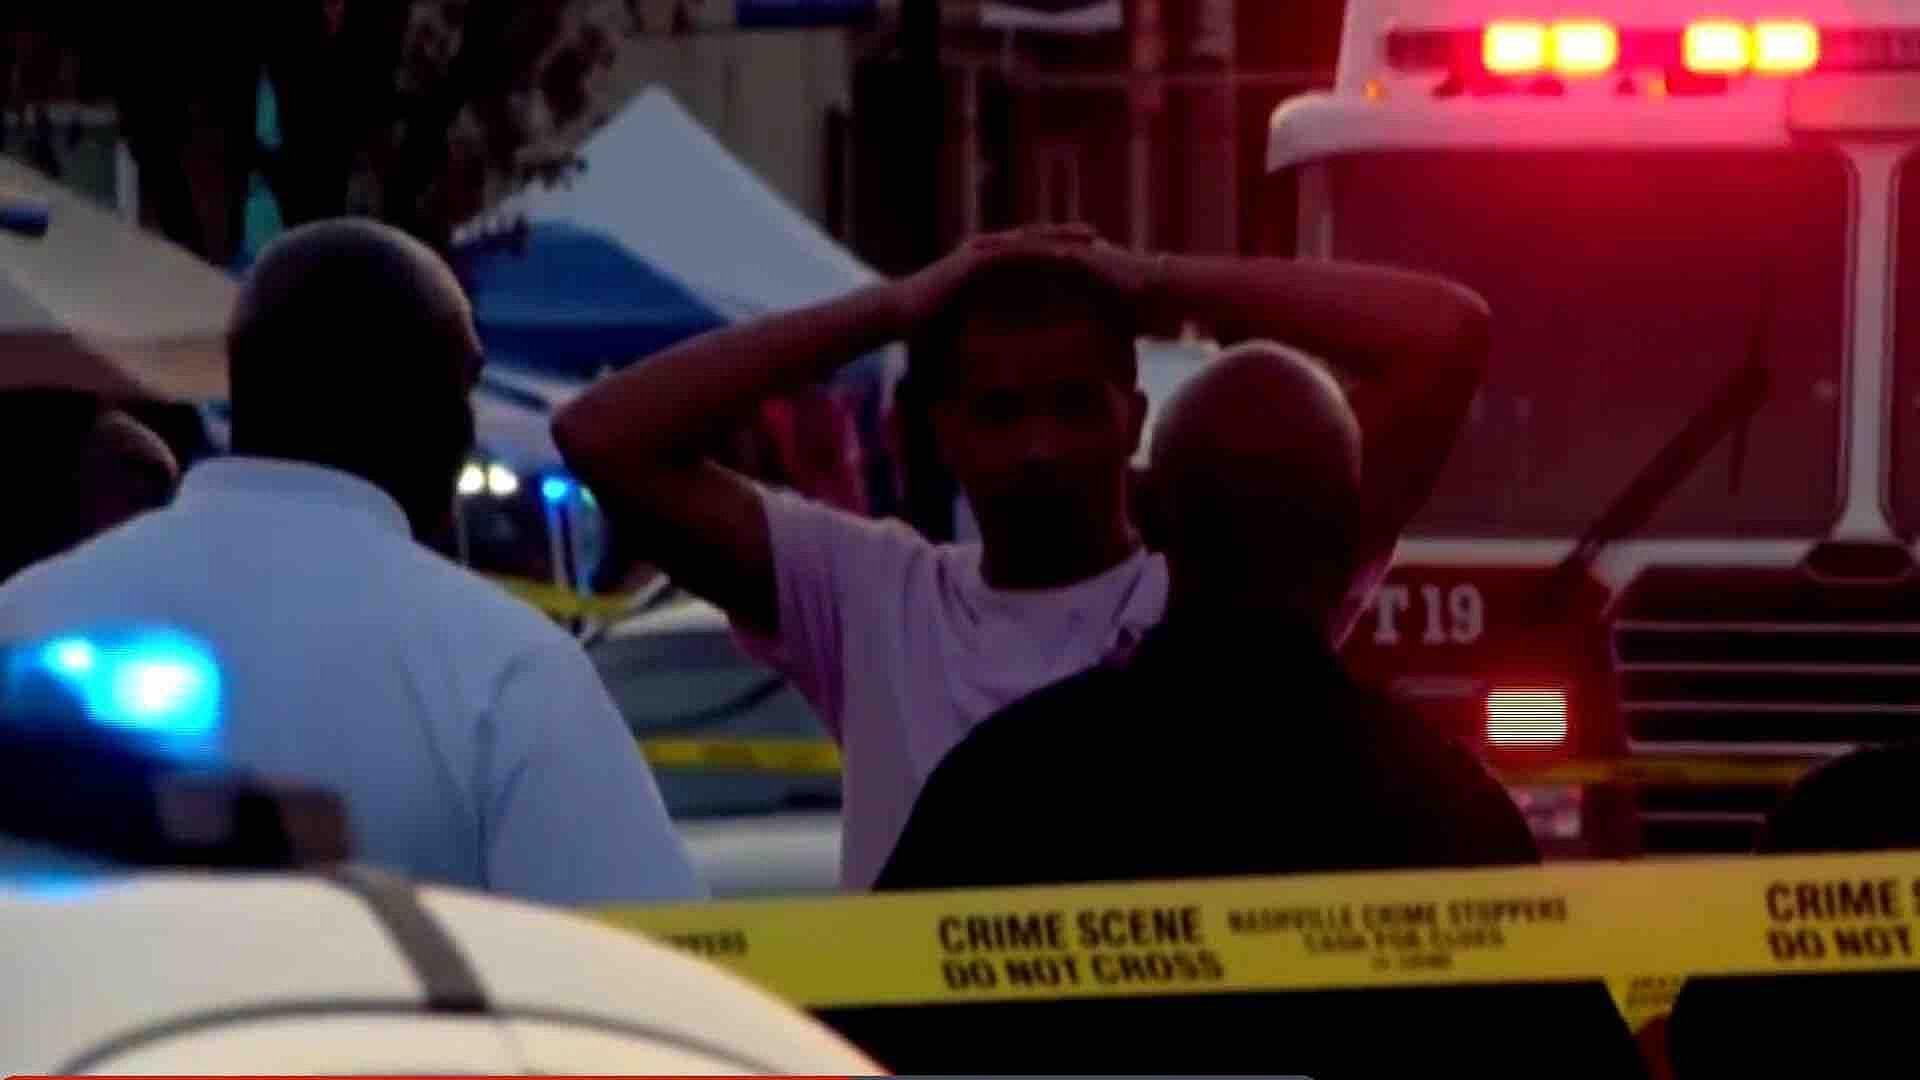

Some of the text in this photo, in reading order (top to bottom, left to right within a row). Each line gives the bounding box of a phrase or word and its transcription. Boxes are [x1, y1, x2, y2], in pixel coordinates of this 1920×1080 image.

[1369, 582, 1484, 646] T 19
[1766, 880, 1898, 921] CRIME
[939, 907, 1200, 950] CRIME SCENE
[1767, 924, 1911, 960] DO NOT
[943, 950, 1224, 989] DO NOT CROSS
